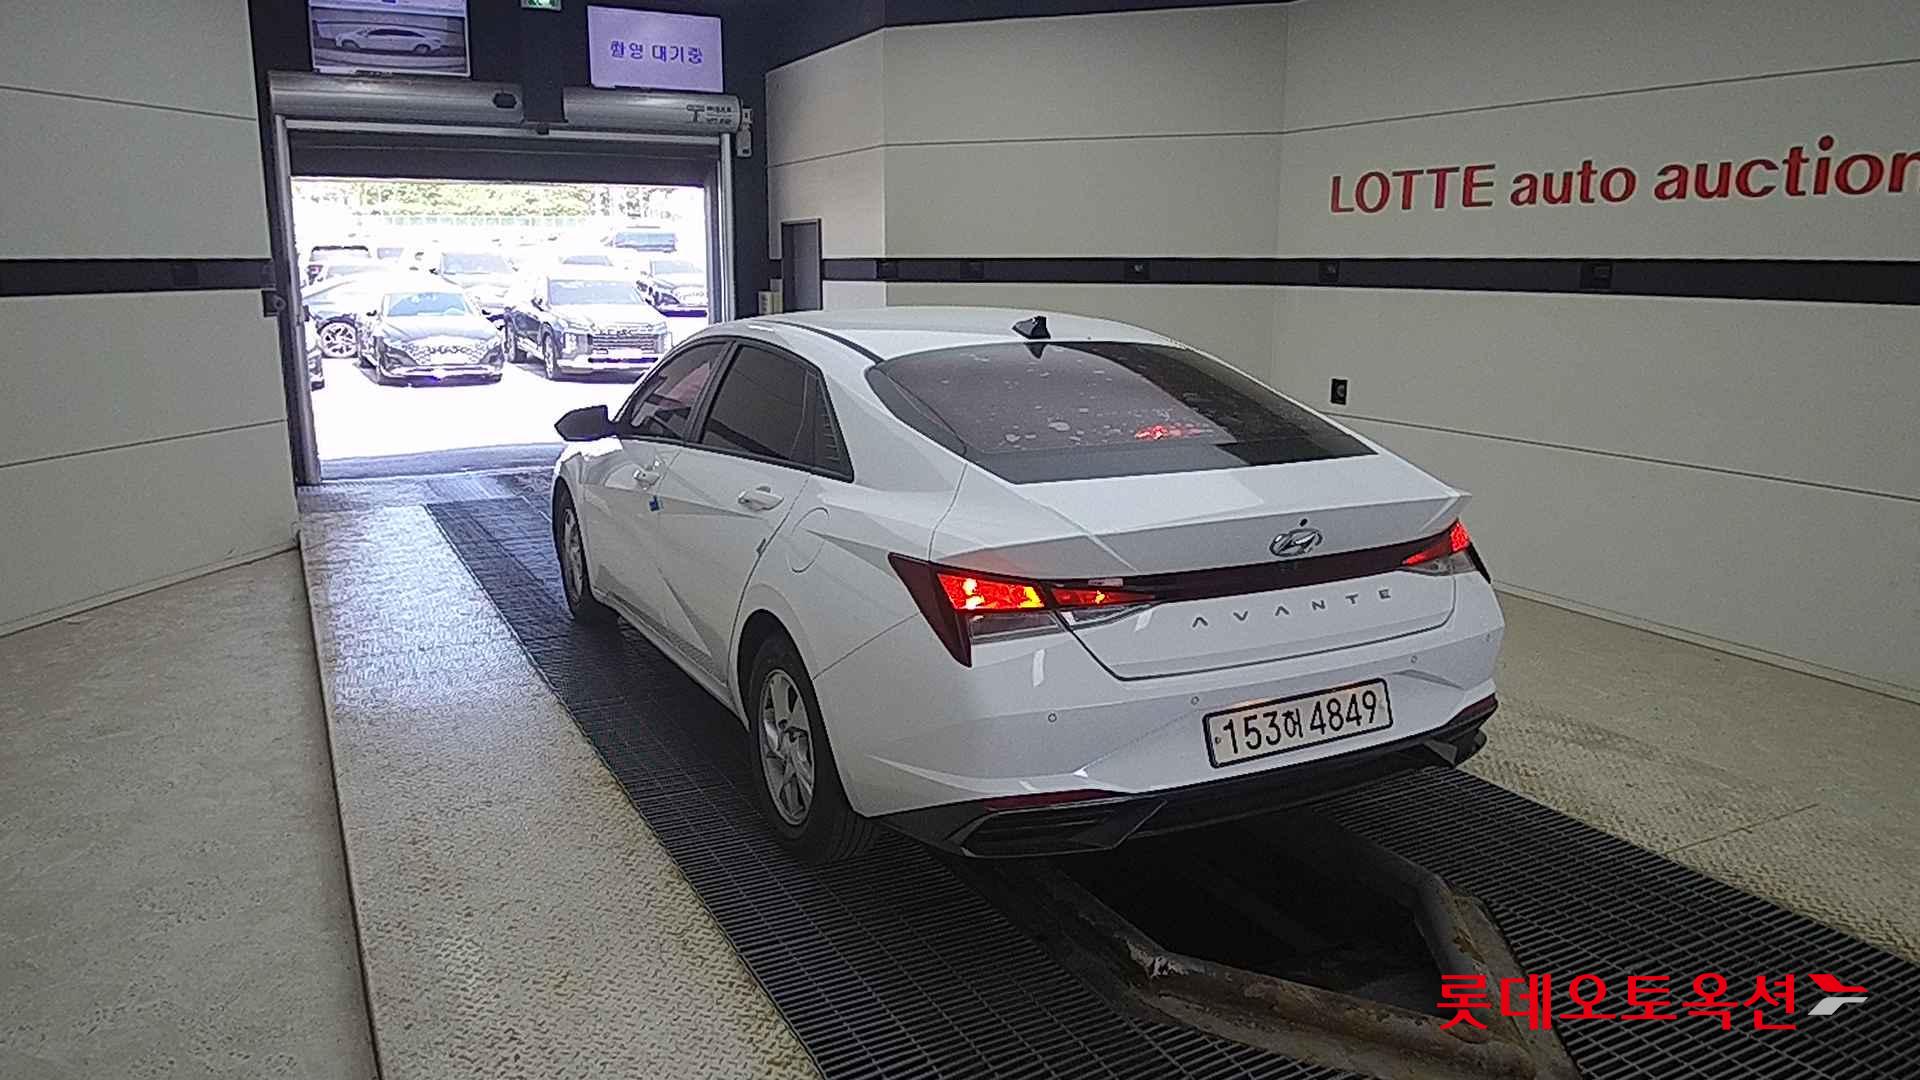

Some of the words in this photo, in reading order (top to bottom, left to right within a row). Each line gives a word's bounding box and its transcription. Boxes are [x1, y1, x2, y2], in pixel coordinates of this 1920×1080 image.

[1331, 164, 1495, 213] LOTTE
[1510, 160, 1636, 206] auto
[1192, 589, 1391, 627] AVANTE
